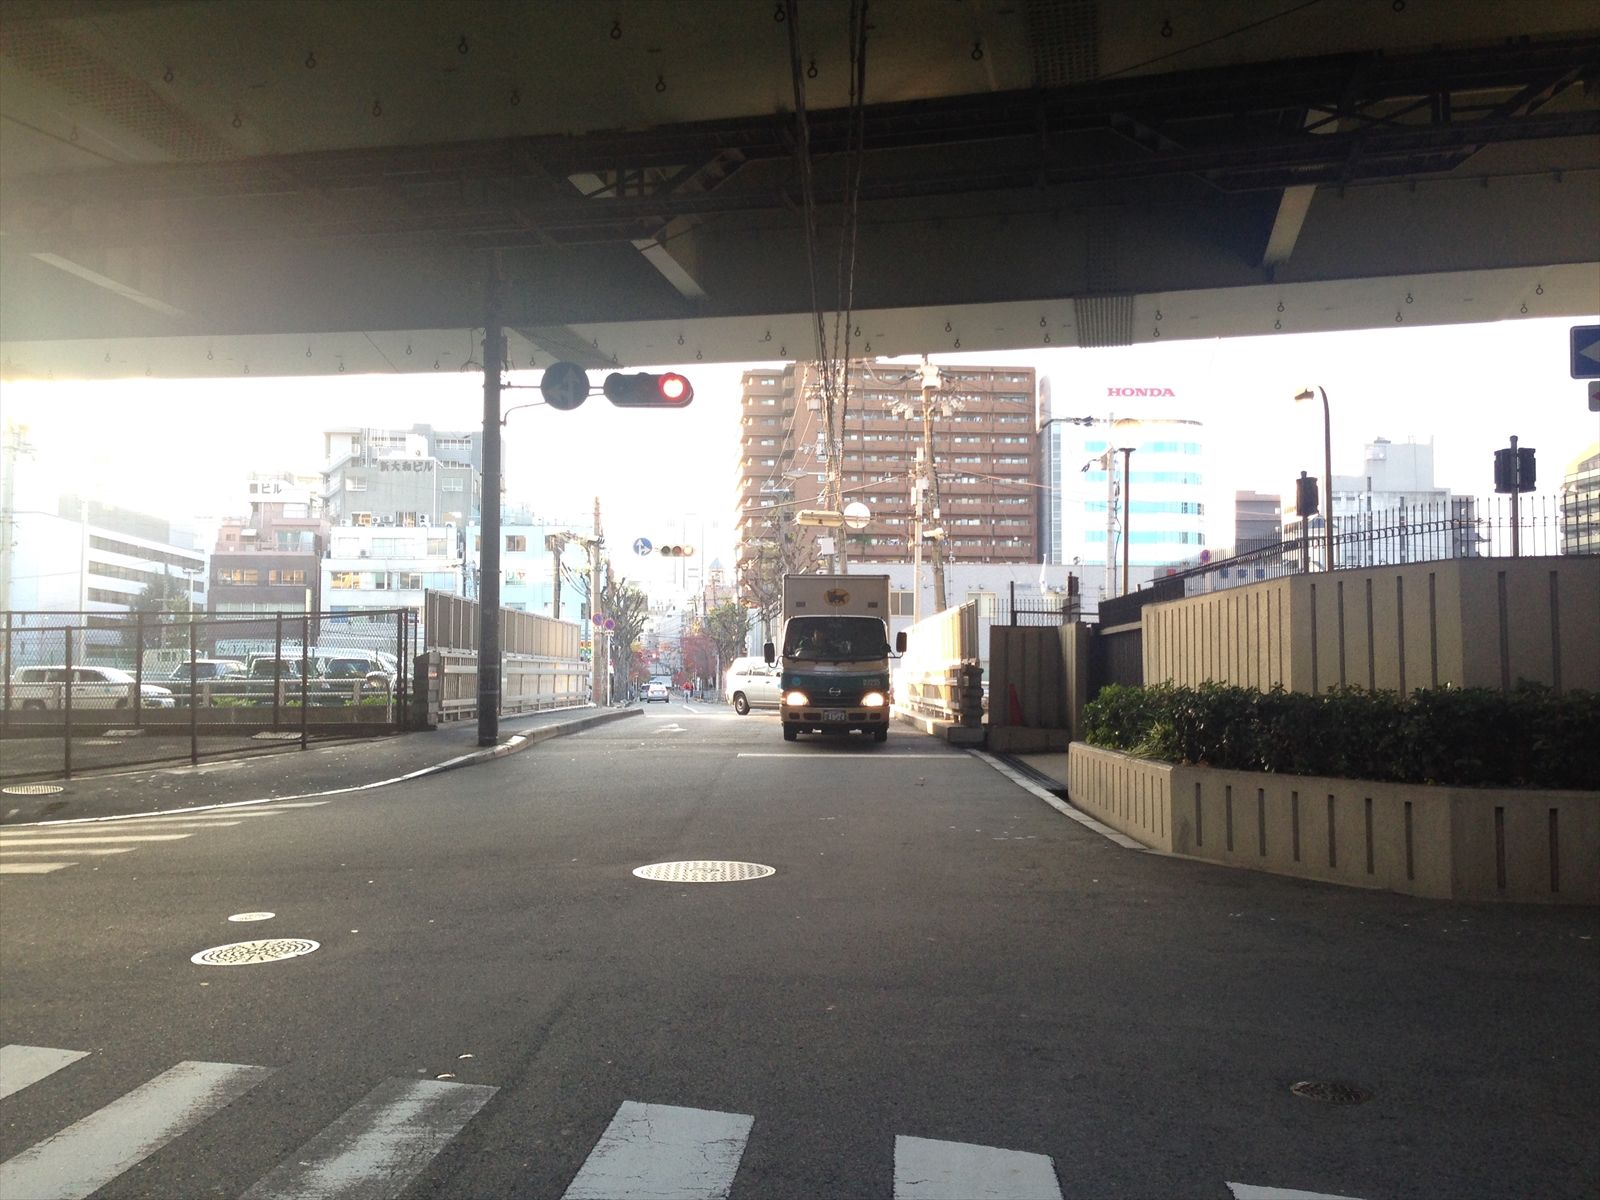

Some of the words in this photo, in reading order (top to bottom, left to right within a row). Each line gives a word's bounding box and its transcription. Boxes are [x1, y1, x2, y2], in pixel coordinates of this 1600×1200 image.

[1107, 387, 1176, 397] HONDA
[379, 460, 433, 472] 新大和ビル
